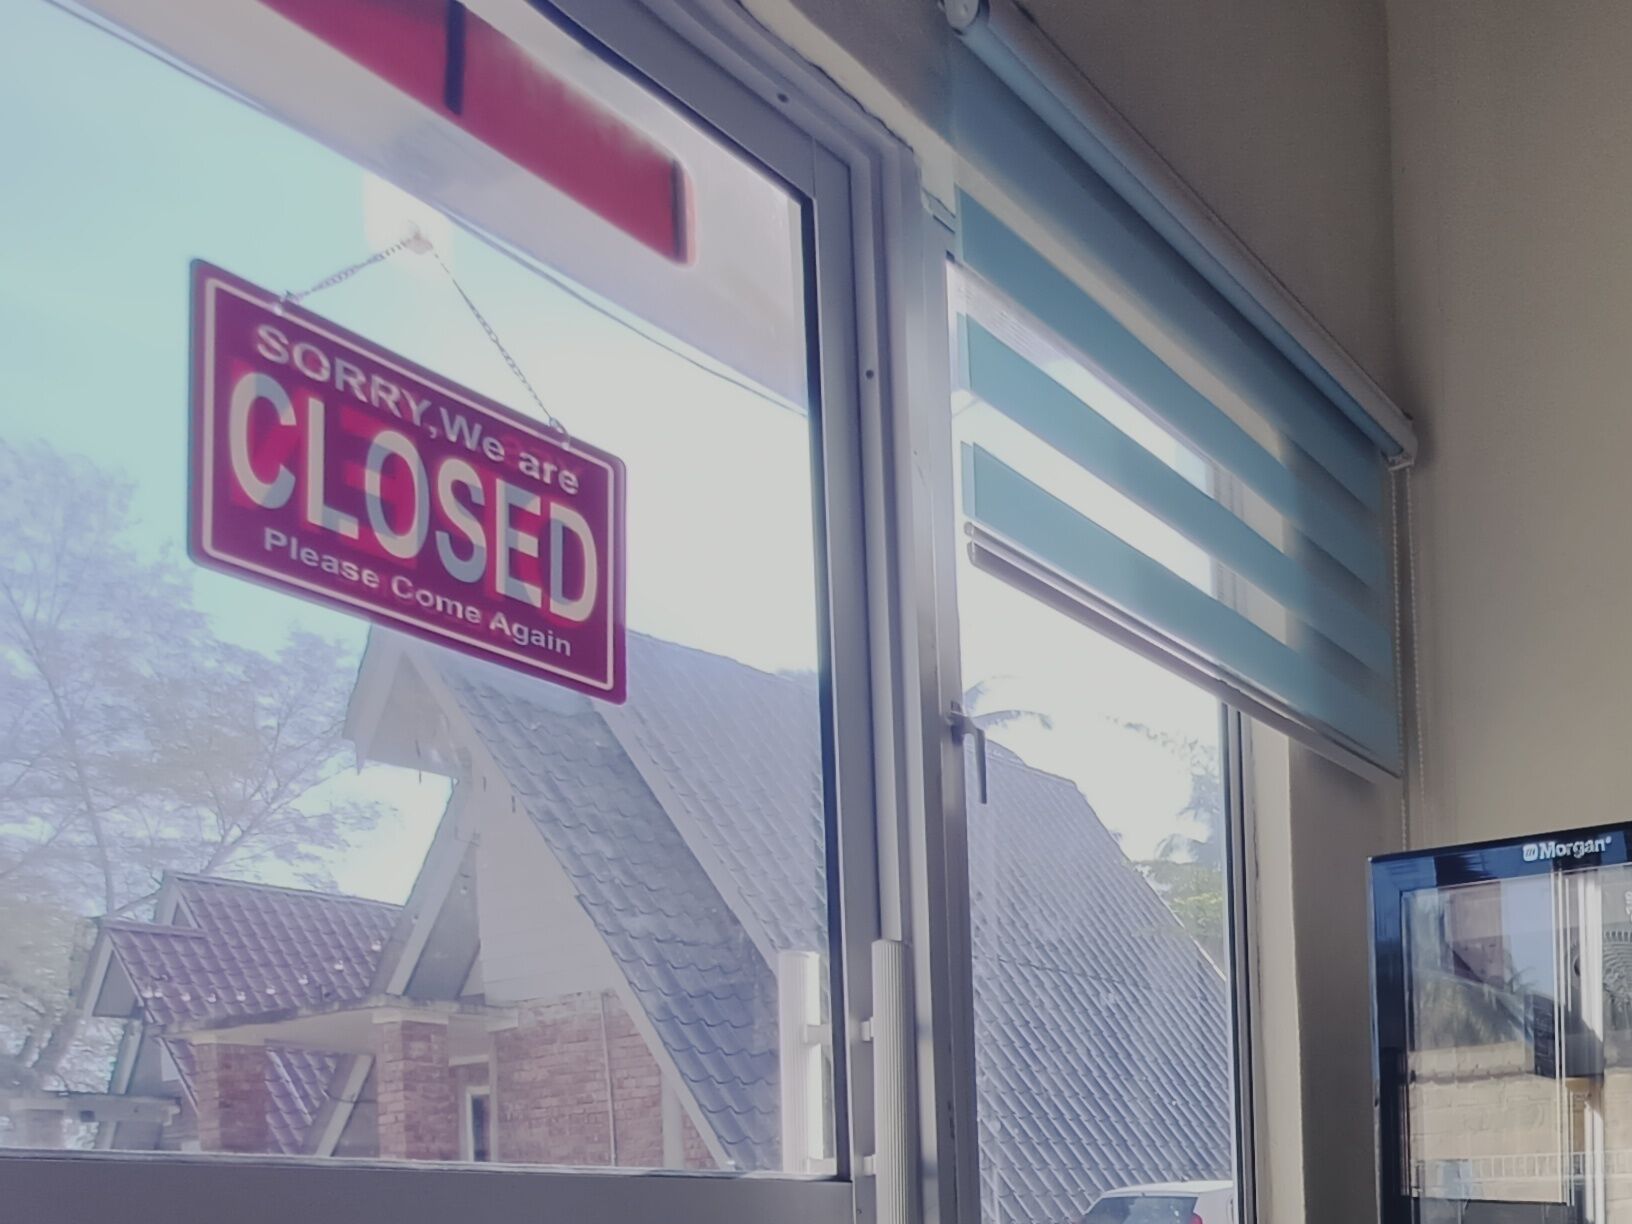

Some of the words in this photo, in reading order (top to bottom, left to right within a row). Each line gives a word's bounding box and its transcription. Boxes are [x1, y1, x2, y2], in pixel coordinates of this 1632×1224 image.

[228, 371, 599, 623] CLOSED
[518, 450, 579, 496] are
[264, 527, 380, 589] Please
[391, 574, 482, 625] Come
[489, 611, 572, 657] Again
[1539, 837, 1606, 859] Morgan
